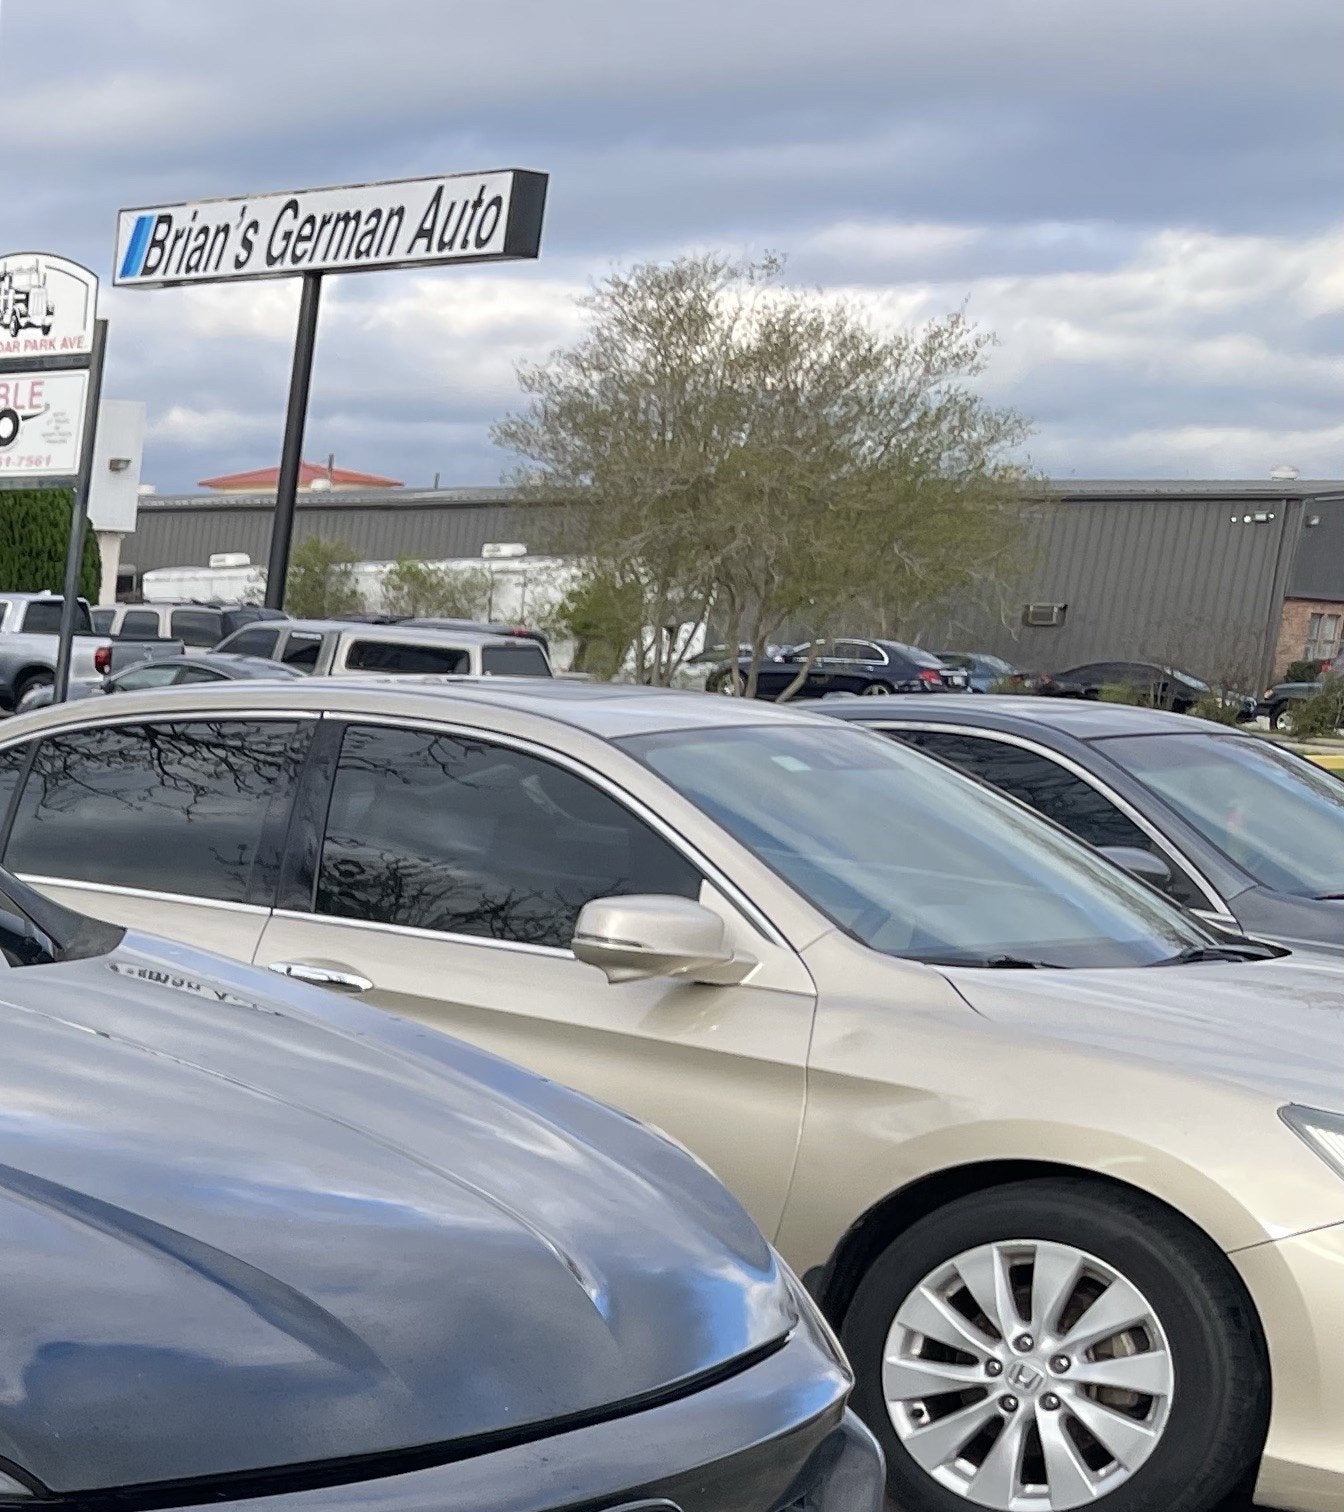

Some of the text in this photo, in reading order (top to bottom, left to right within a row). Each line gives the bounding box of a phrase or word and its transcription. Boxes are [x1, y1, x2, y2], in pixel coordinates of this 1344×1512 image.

[140, 183, 504, 276] Brian's German Auto
[24, 337, 56, 351] PARK
[60, 335, 85, 350] AVE
